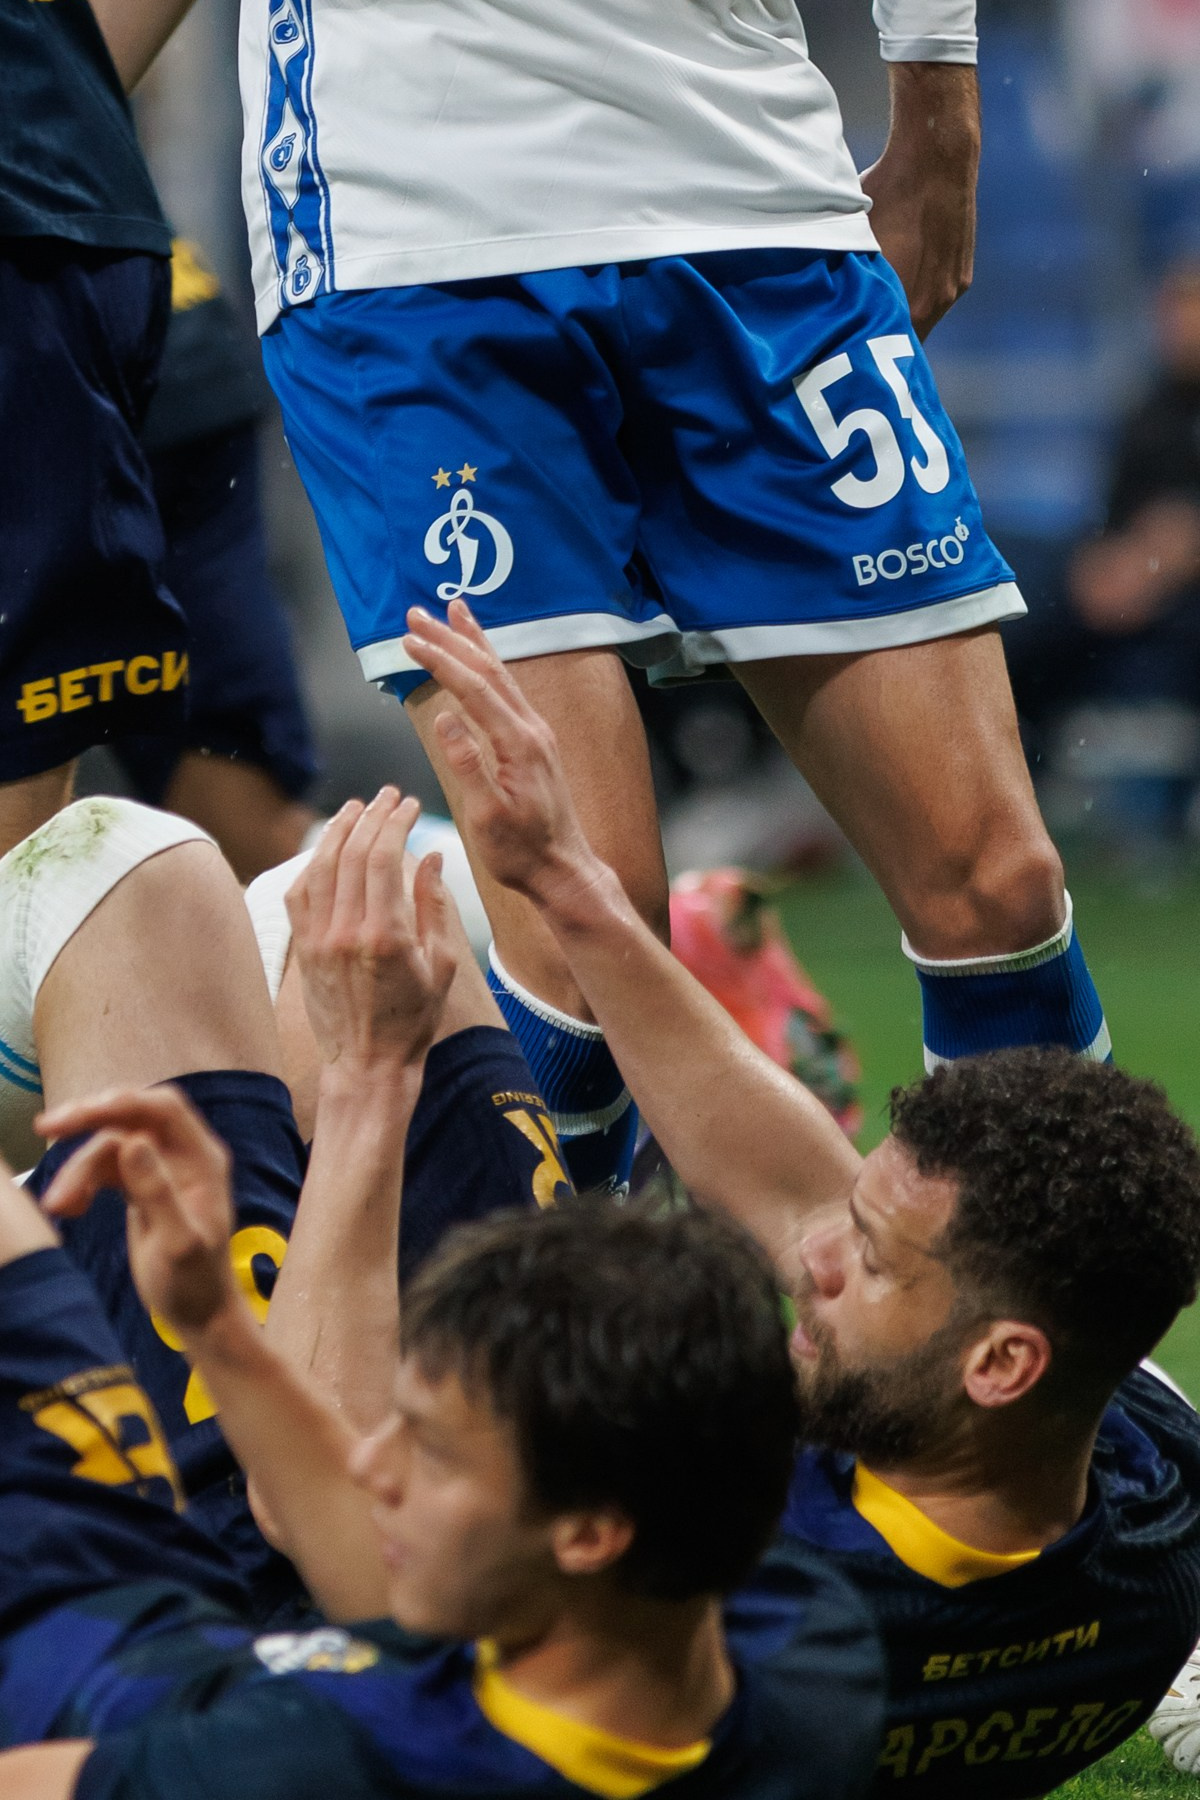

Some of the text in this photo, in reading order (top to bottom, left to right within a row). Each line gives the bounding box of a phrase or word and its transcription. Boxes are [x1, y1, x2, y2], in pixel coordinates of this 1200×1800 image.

[791, 334, 951, 509] 55
[851, 534, 965, 587] BOSCO
[921, 1620, 1101, 1682] БЕТСИТИ
